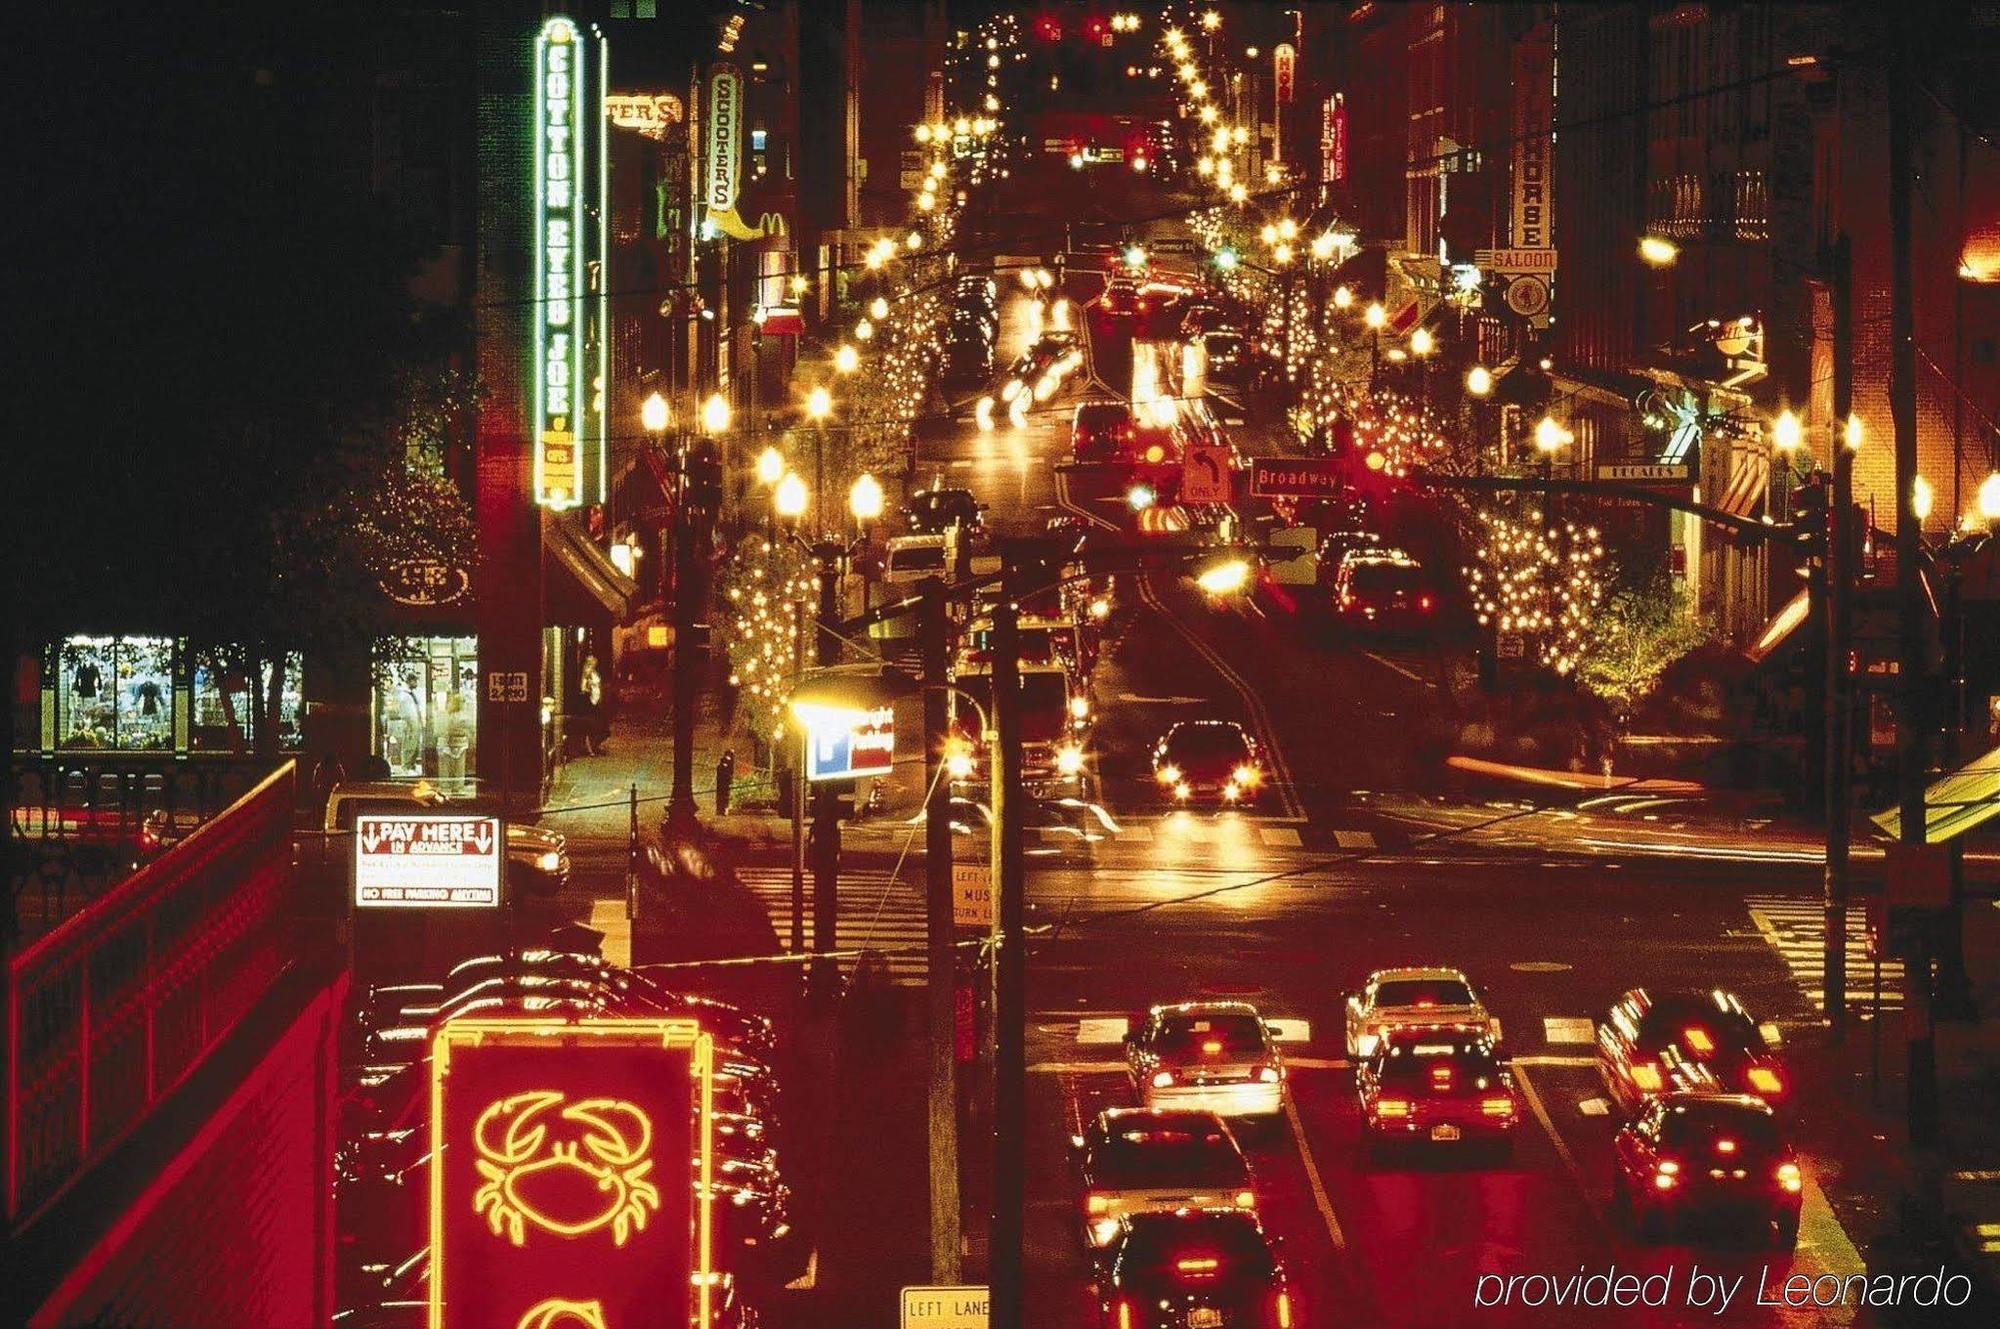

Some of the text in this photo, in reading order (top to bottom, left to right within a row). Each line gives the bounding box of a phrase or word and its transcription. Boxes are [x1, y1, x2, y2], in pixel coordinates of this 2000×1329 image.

[547, 45, 570, 208] COTTON
[1494, 252, 1554, 267] SALOON
[1259, 470, 1338, 488] Broadway
[380, 822, 476, 842] PAY HERE
[391, 842, 463, 854] IN ADVANCE
[956, 872, 978, 882] LEFT
[363, 889, 380, 899] NO
[910, 1302, 990, 1316] LEFT LANE
